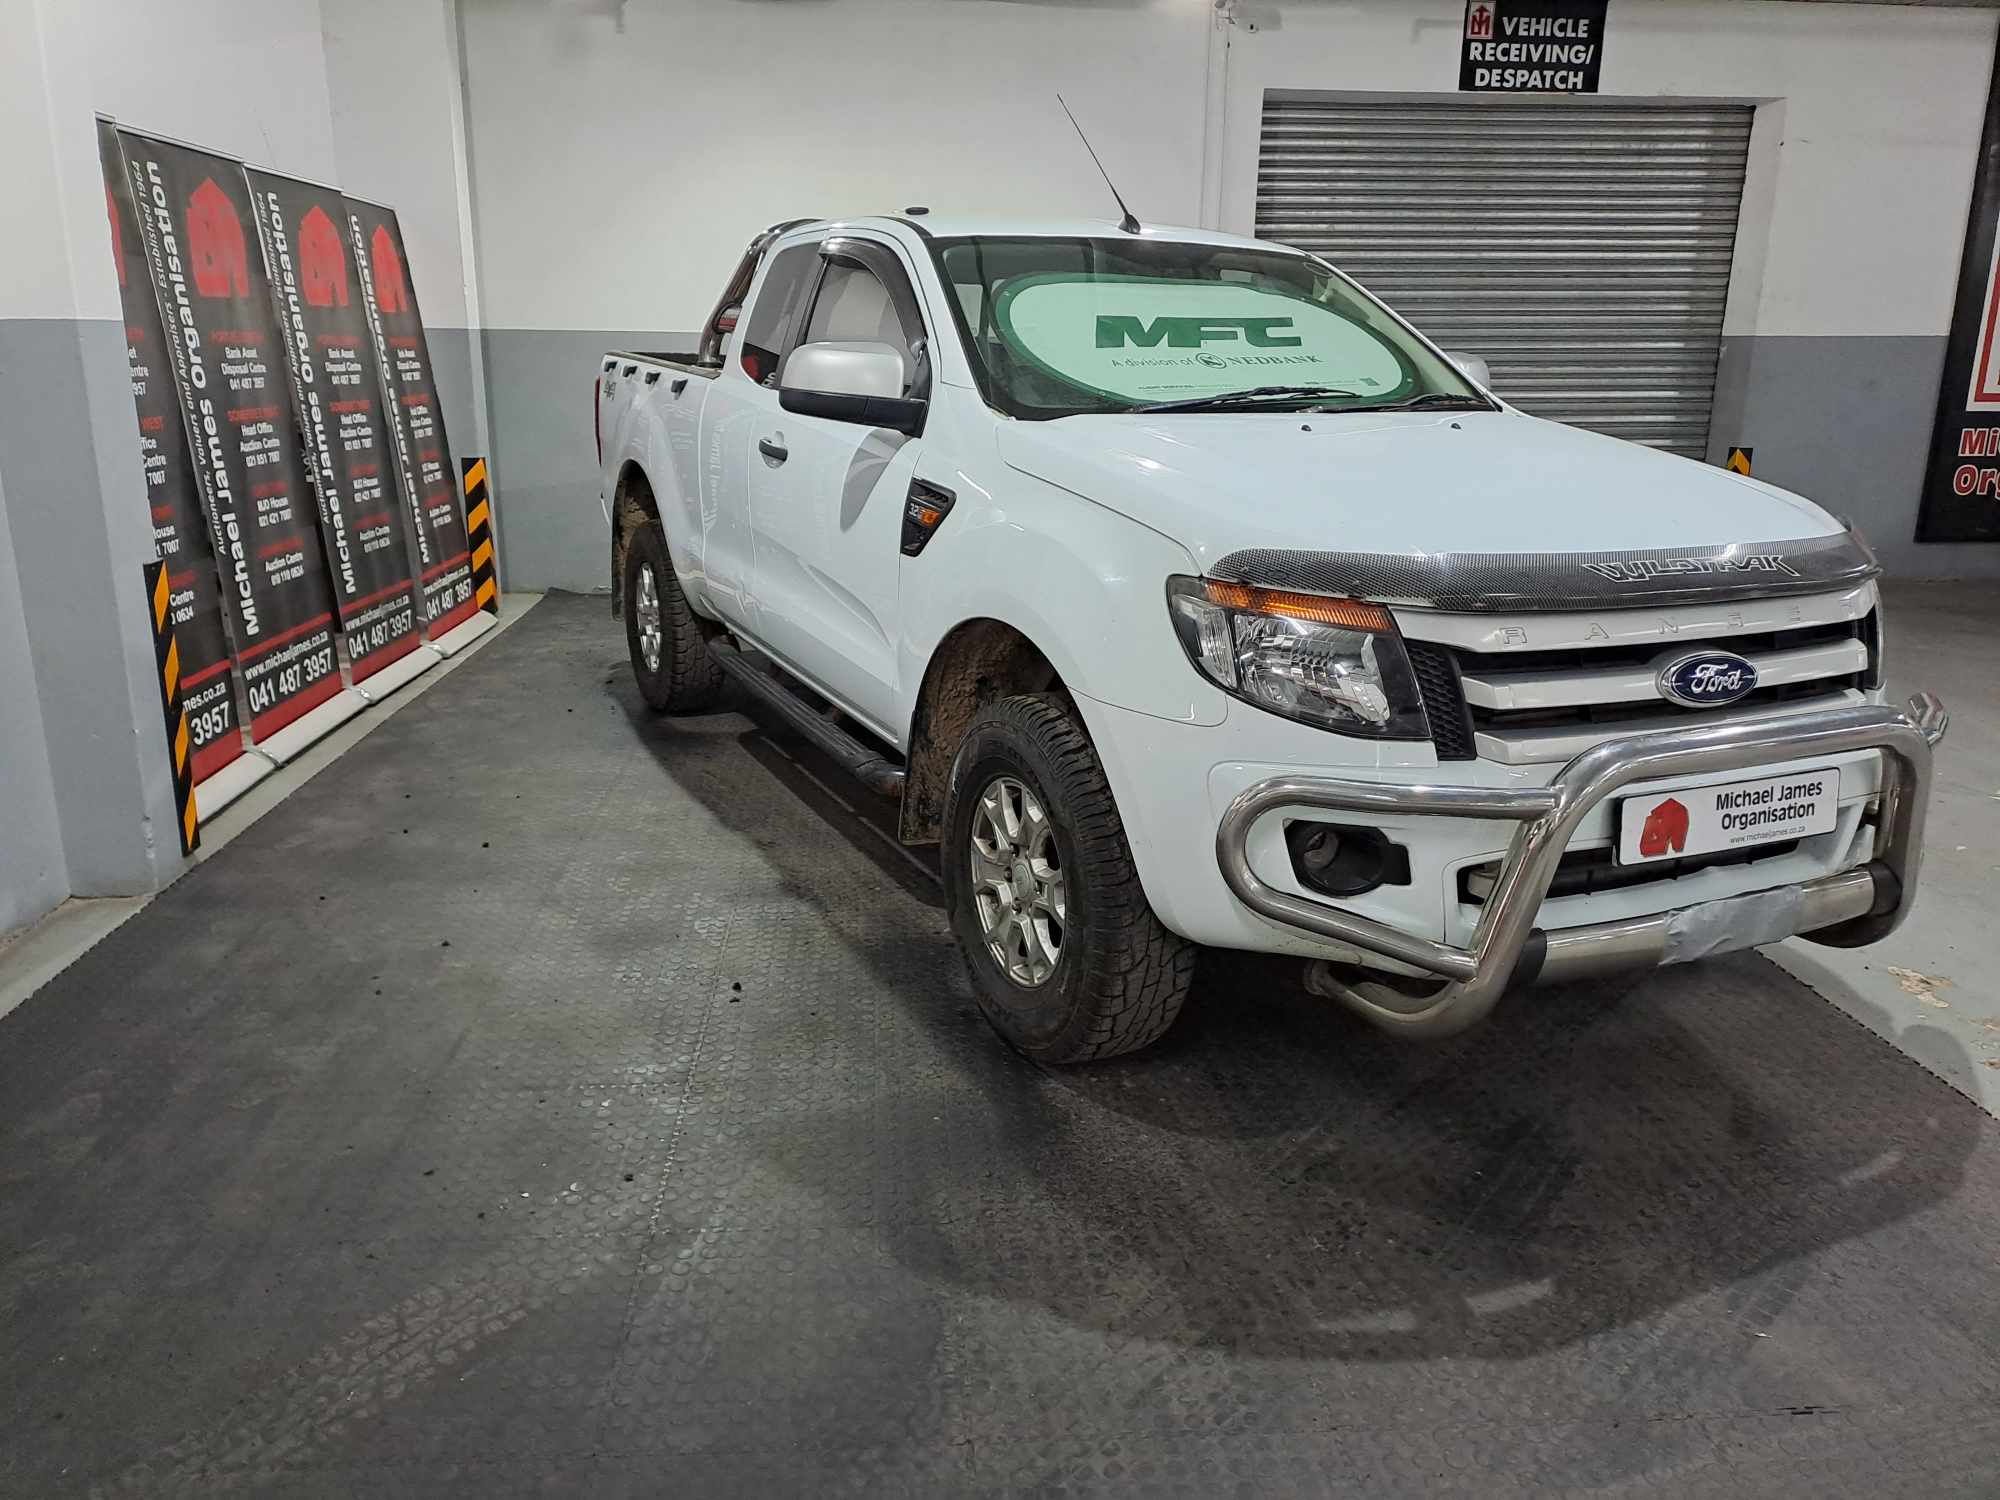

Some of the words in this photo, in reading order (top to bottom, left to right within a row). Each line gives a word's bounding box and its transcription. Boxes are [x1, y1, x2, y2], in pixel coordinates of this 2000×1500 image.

[1502, 17, 1589, 38] VEHICLE
[1469, 42, 1594, 65] RECEIVING/
[1475, 68, 1584, 90] DESPATCH
[145, 205, 167, 290] Established
[147, 160, 207, 390] Organisation
[267, 192, 314, 384] Organisation
[166, 303, 188, 379] Appraisers
[1095, 315, 1302, 349] MFC
[130, 365, 149, 377] entre
[1125, 358, 1179, 367] division
[1226, 355, 1323, 365] NEDBANK
[133, 382, 146, 396] 957
[182, 381, 195, 411] and
[189, 413, 207, 465] Valuers
[199, 398, 233, 505] James
[308, 391, 334, 480] James
[1958, 427, 2000, 456] Mi
[1953, 464, 2000, 500] Or
[325, 489, 357, 594] Michael
[221, 512, 260, 636] Michael
[426, 597, 441, 620] 041
[441, 589, 454, 610] 487
[455, 578, 472, 603] 3957
[348, 632, 369, 659] 041
[371, 617, 388, 646] 487
[390, 610, 412, 636] 3957
[249, 682, 275, 713] 041
[279, 663, 300, 696] 487
[304, 647, 332, 682] 3957
[1691, 663, 1744, 694] Ford
[183, 682, 227, 712] mes.co.za
[191, 701, 230, 745] 3957
[1716, 786, 1774, 811] Michael
[1778, 781, 1823, 801] James
[1721, 802, 1815, 830] Organisation
